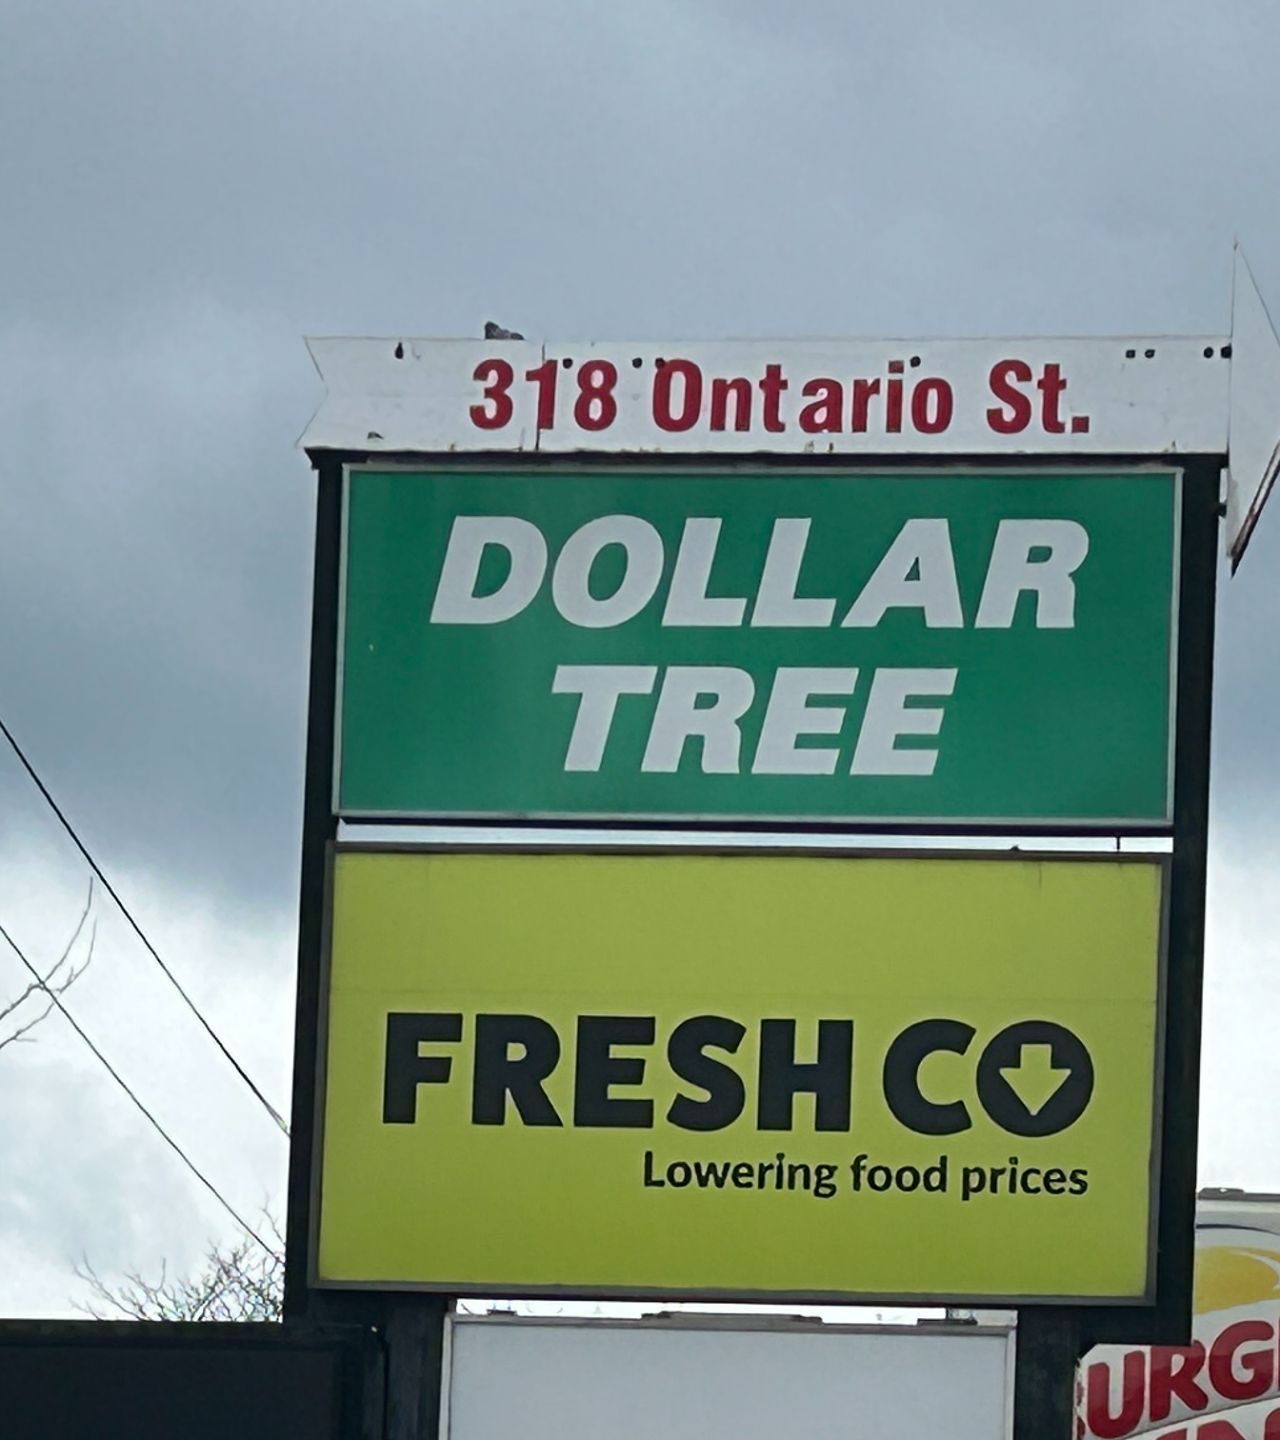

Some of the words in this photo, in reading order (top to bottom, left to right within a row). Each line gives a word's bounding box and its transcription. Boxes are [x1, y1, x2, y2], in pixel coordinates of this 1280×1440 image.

[470, 358, 617, 432] 318
[653, 356, 953, 434] Ontario
[987, 360, 1089, 434] St.
[430, 515, 1089, 628] DOLLAR
[552, 665, 957, 775] TREE
[644, 1151, 838, 1198] Lowering
[851, 1155, 947, 1192] food
[962, 1157, 1087, 1201] prices
